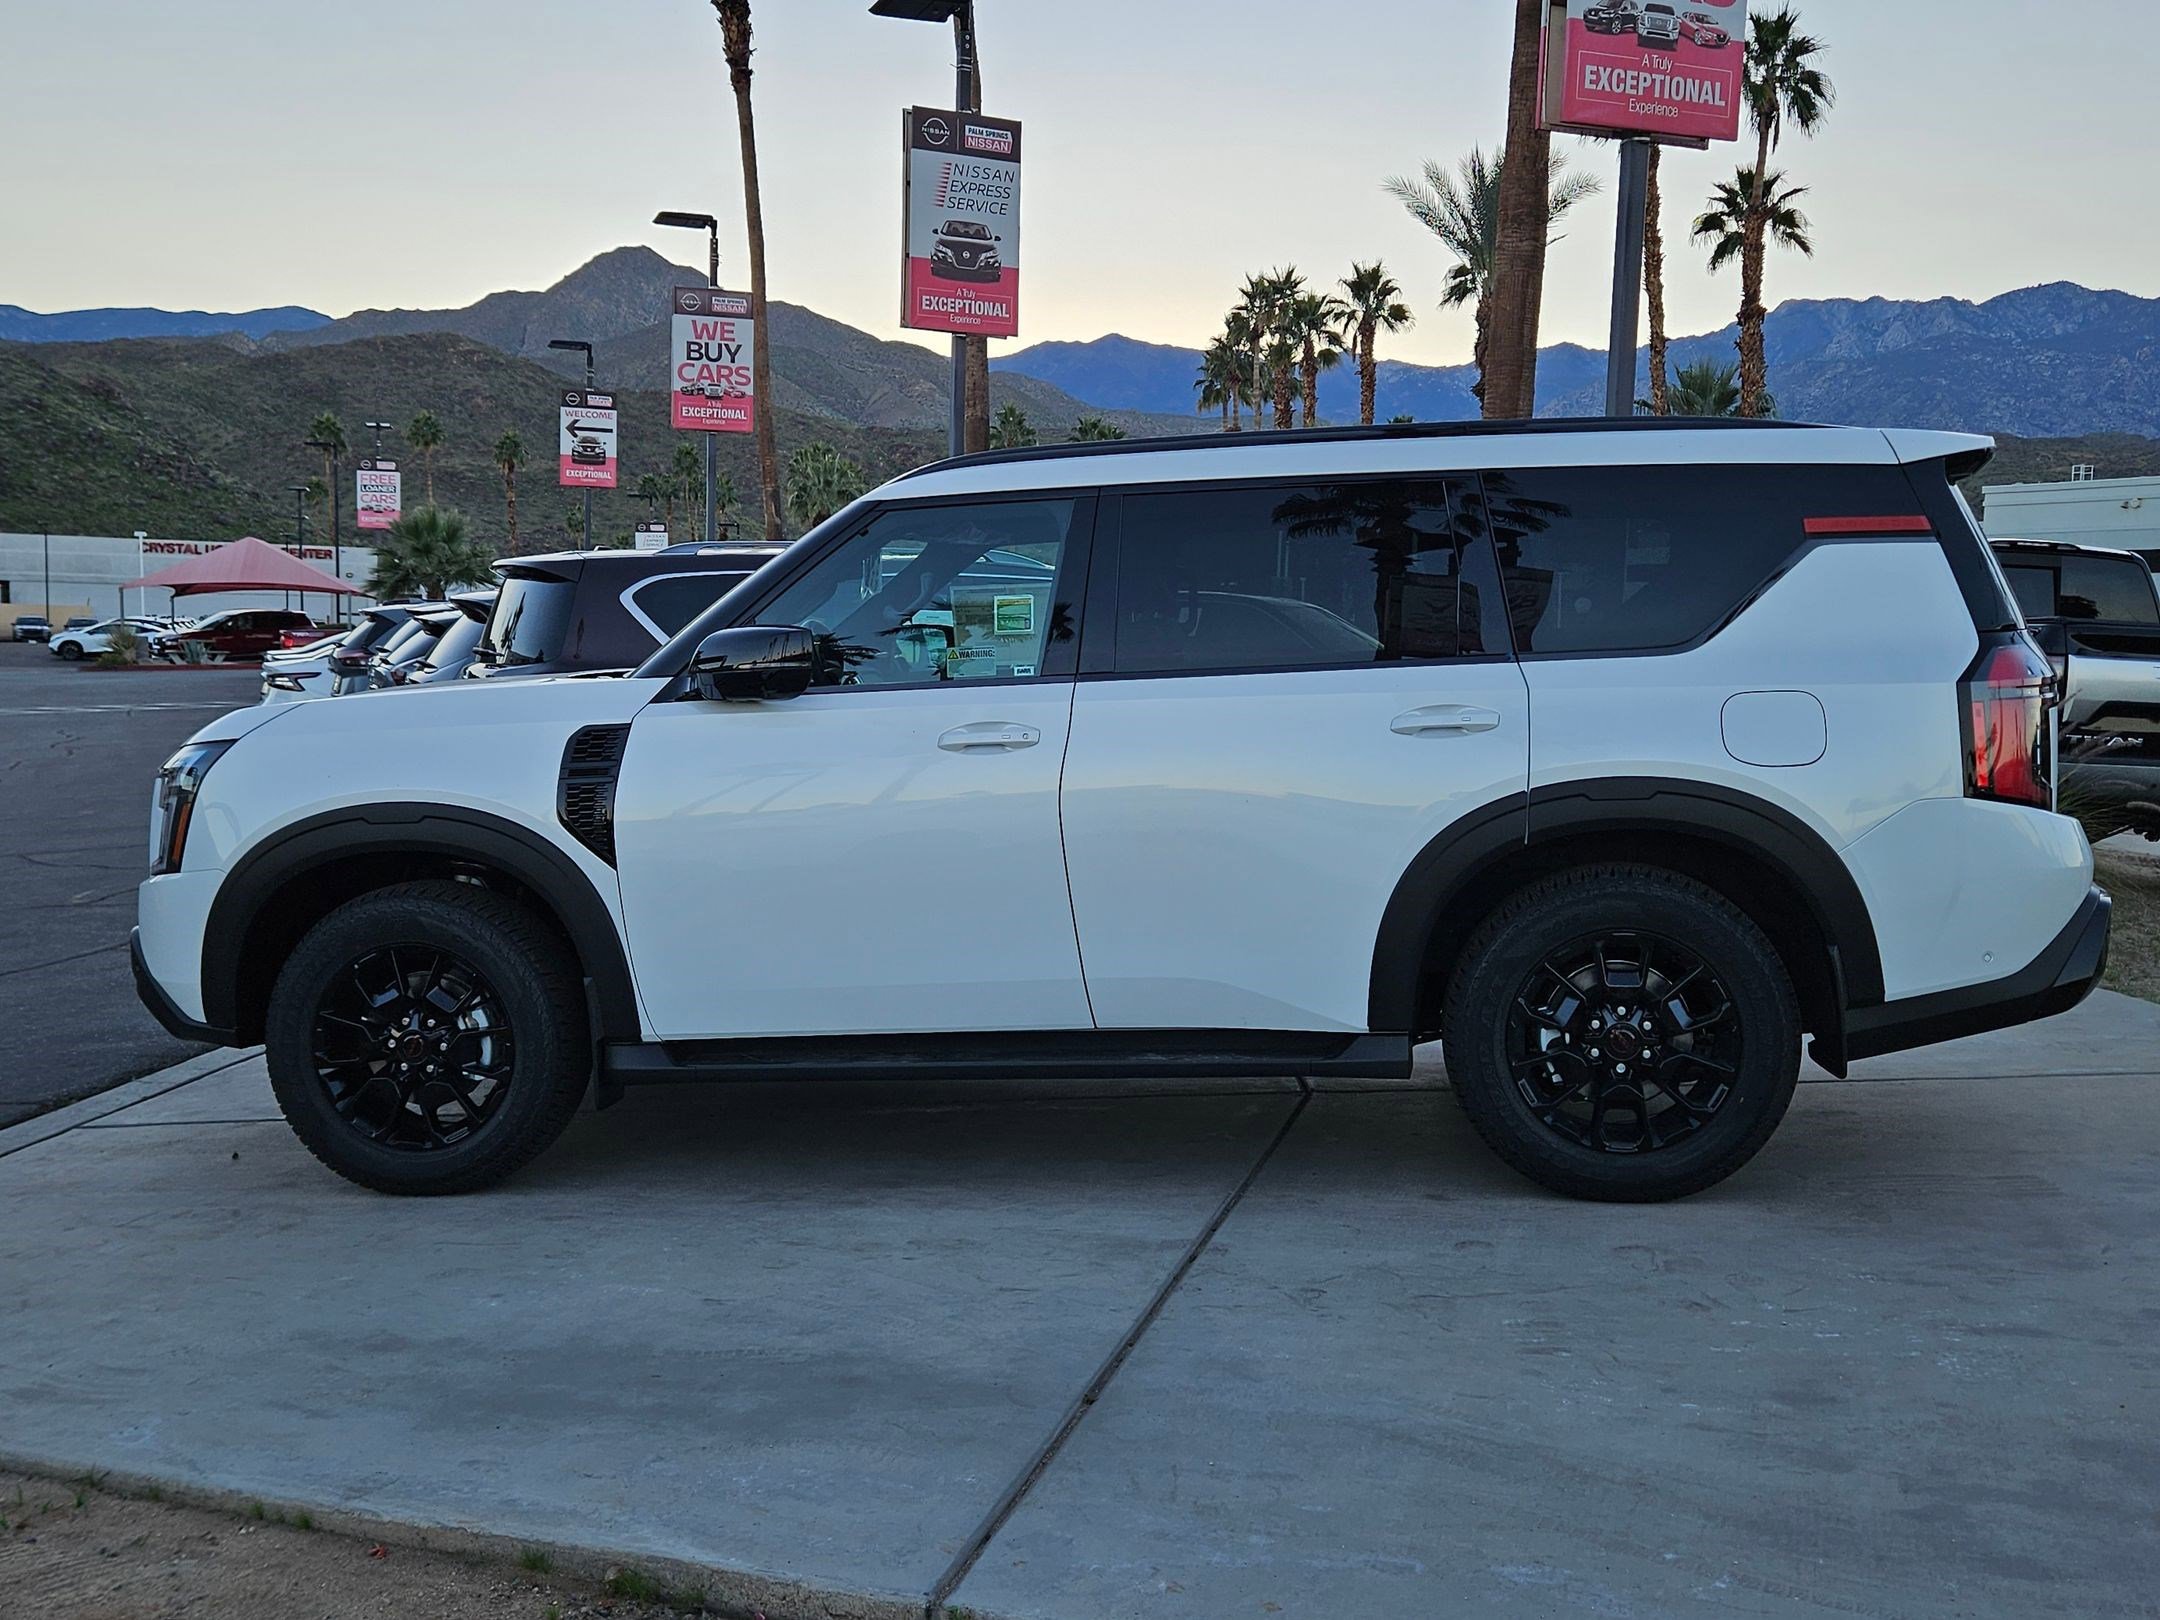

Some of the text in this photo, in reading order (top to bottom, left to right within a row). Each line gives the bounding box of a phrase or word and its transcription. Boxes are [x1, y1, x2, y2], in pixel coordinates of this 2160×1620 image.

[1641, 53, 1673, 73] A Truly
[1584, 64, 1726, 107] EXCEPTIONAL
[1628, 98, 1679, 118] Experience
[921, 126, 950, 137] NISSAN
[967, 127, 1009, 140] PALM SPRINGS
[967, 136, 1010, 152] NISSAN
[953, 163, 1015, 183] NISSAN
[950, 180, 1012, 199] EXPRESS
[947, 197, 1008, 216] SERVICE
[956, 288, 976, 301] A Truly
[714, 304, 745, 313] NISSAN
[922, 295, 1010, 318] EXCEPTIONAL
[949, 313, 982, 325] Experience
[691, 320, 736, 342] WE
[686, 341, 742, 364] BUY
[677, 362, 752, 387] CARS
[564, 409, 613, 420] WELCOME
[682, 406, 747, 420] EXCEPTIONAL
[360, 473, 397, 485] FREE
[566, 469, 612, 480] EXCEPTIONAL
[360, 493, 397, 505] CARS
[138, 541, 202, 555] CRYSTAL
[959, 649, 995, 659] WARNING:
